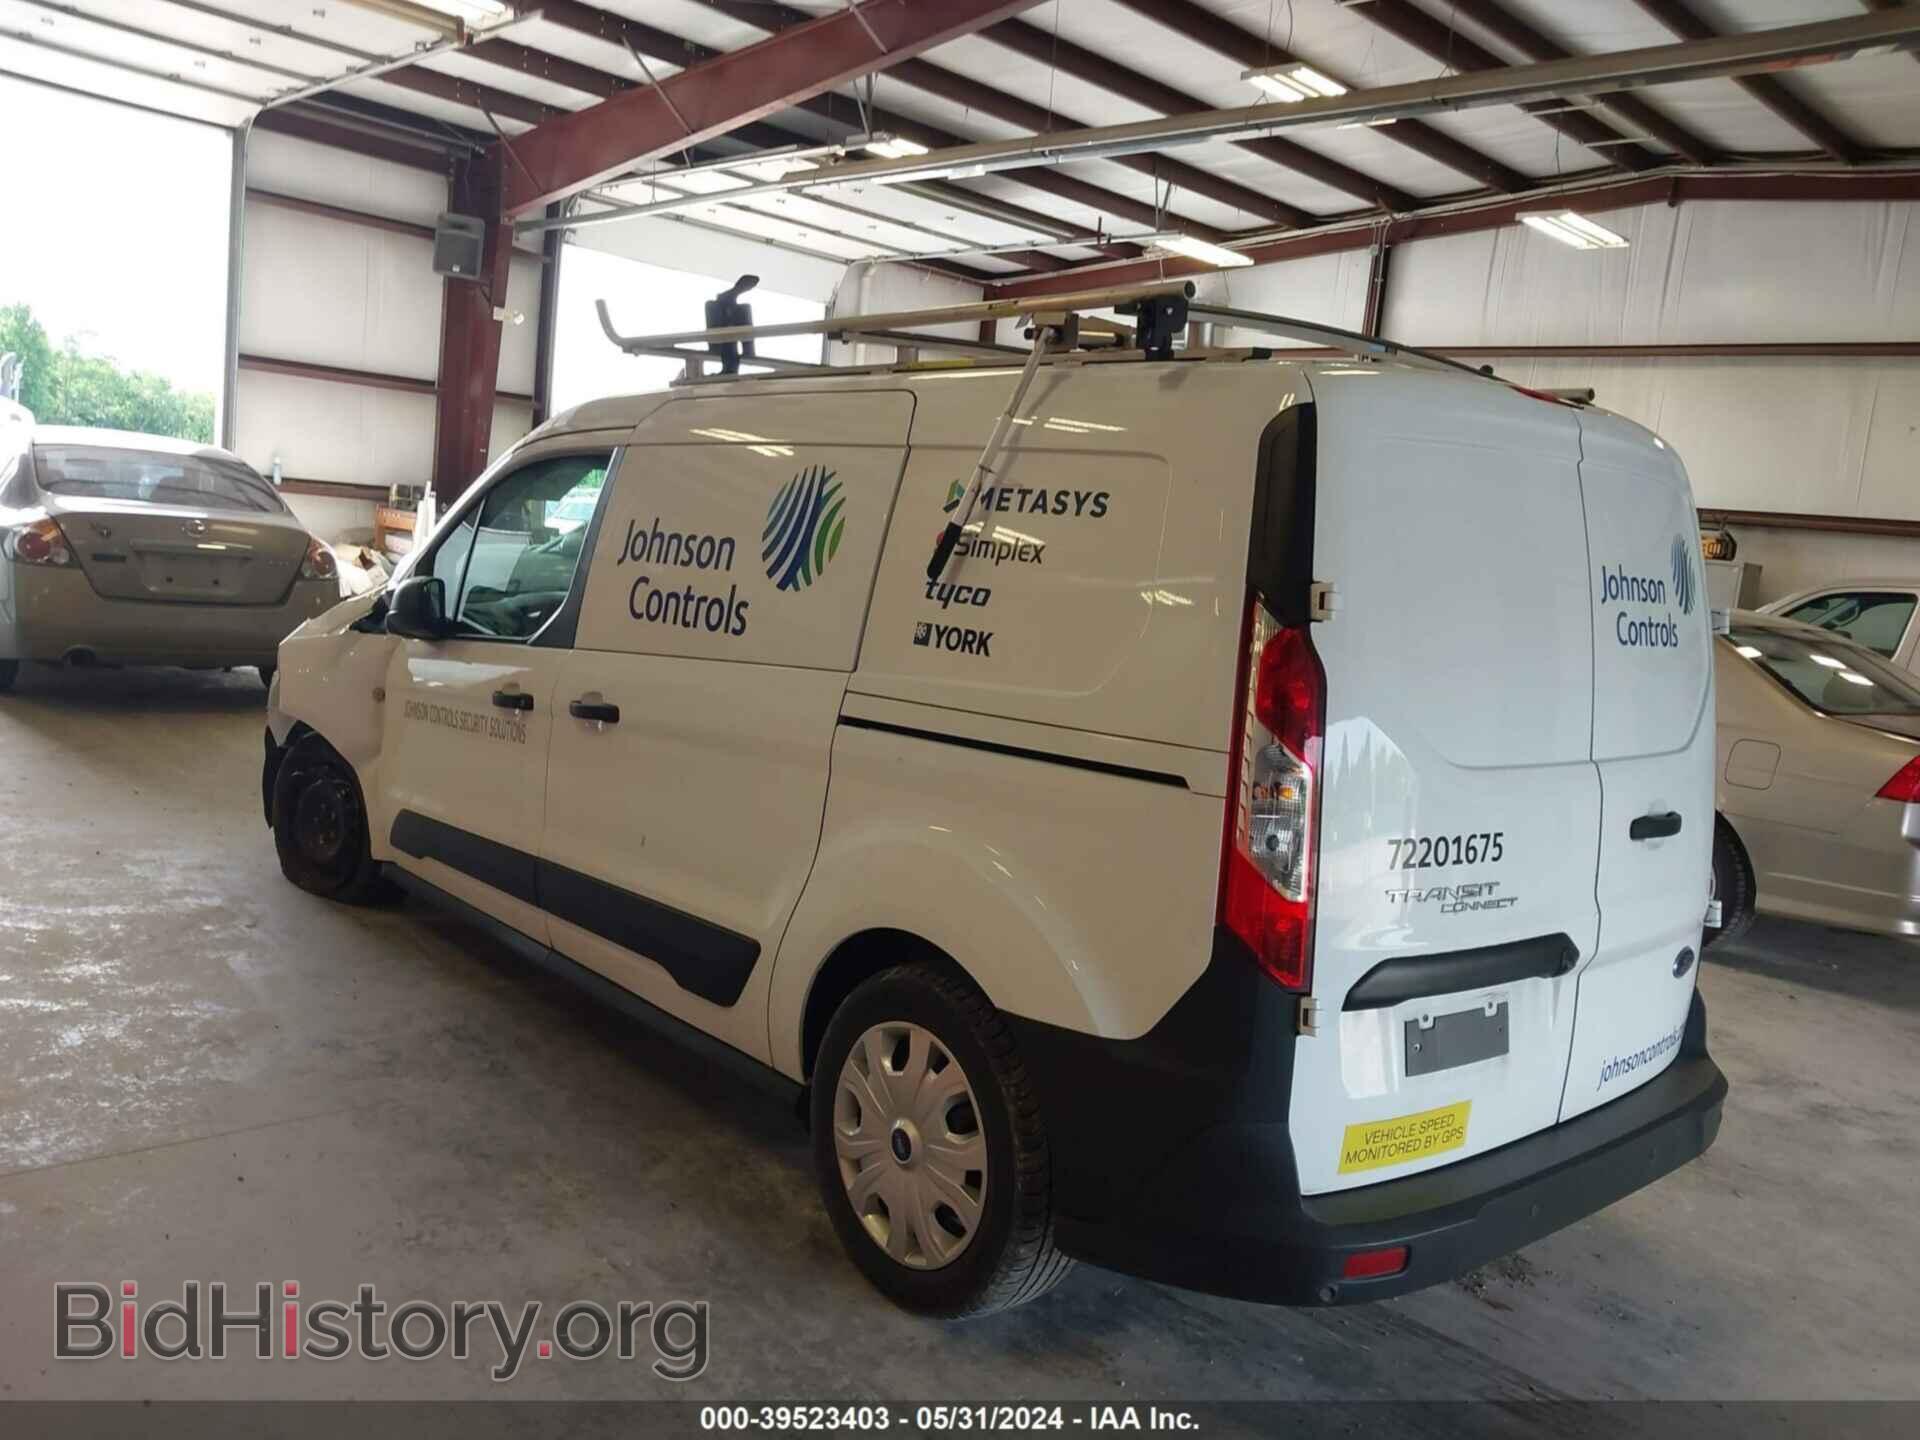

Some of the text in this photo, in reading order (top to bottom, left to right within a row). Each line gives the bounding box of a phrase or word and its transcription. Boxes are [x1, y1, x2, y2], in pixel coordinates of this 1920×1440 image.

[617, 517, 736, 571] Johnson
[954, 533, 1046, 566] Simplex
[925, 578, 992, 610] tyco
[1601, 563, 1666, 605] Johnson
[629, 575, 749, 636] Controls
[934, 623, 994, 658] YORK
[1616, 611, 1679, 648] Controls
[1387, 832, 1504, 871] 72201675
[1384, 881, 1501, 904] TRANSIT
[1440, 896, 1519, 914] CONNECT
[1344, 1126, 1465, 1165] MONITORED BY GPS
[1364, 1113, 1456, 1145] VEHICLE SPEED
